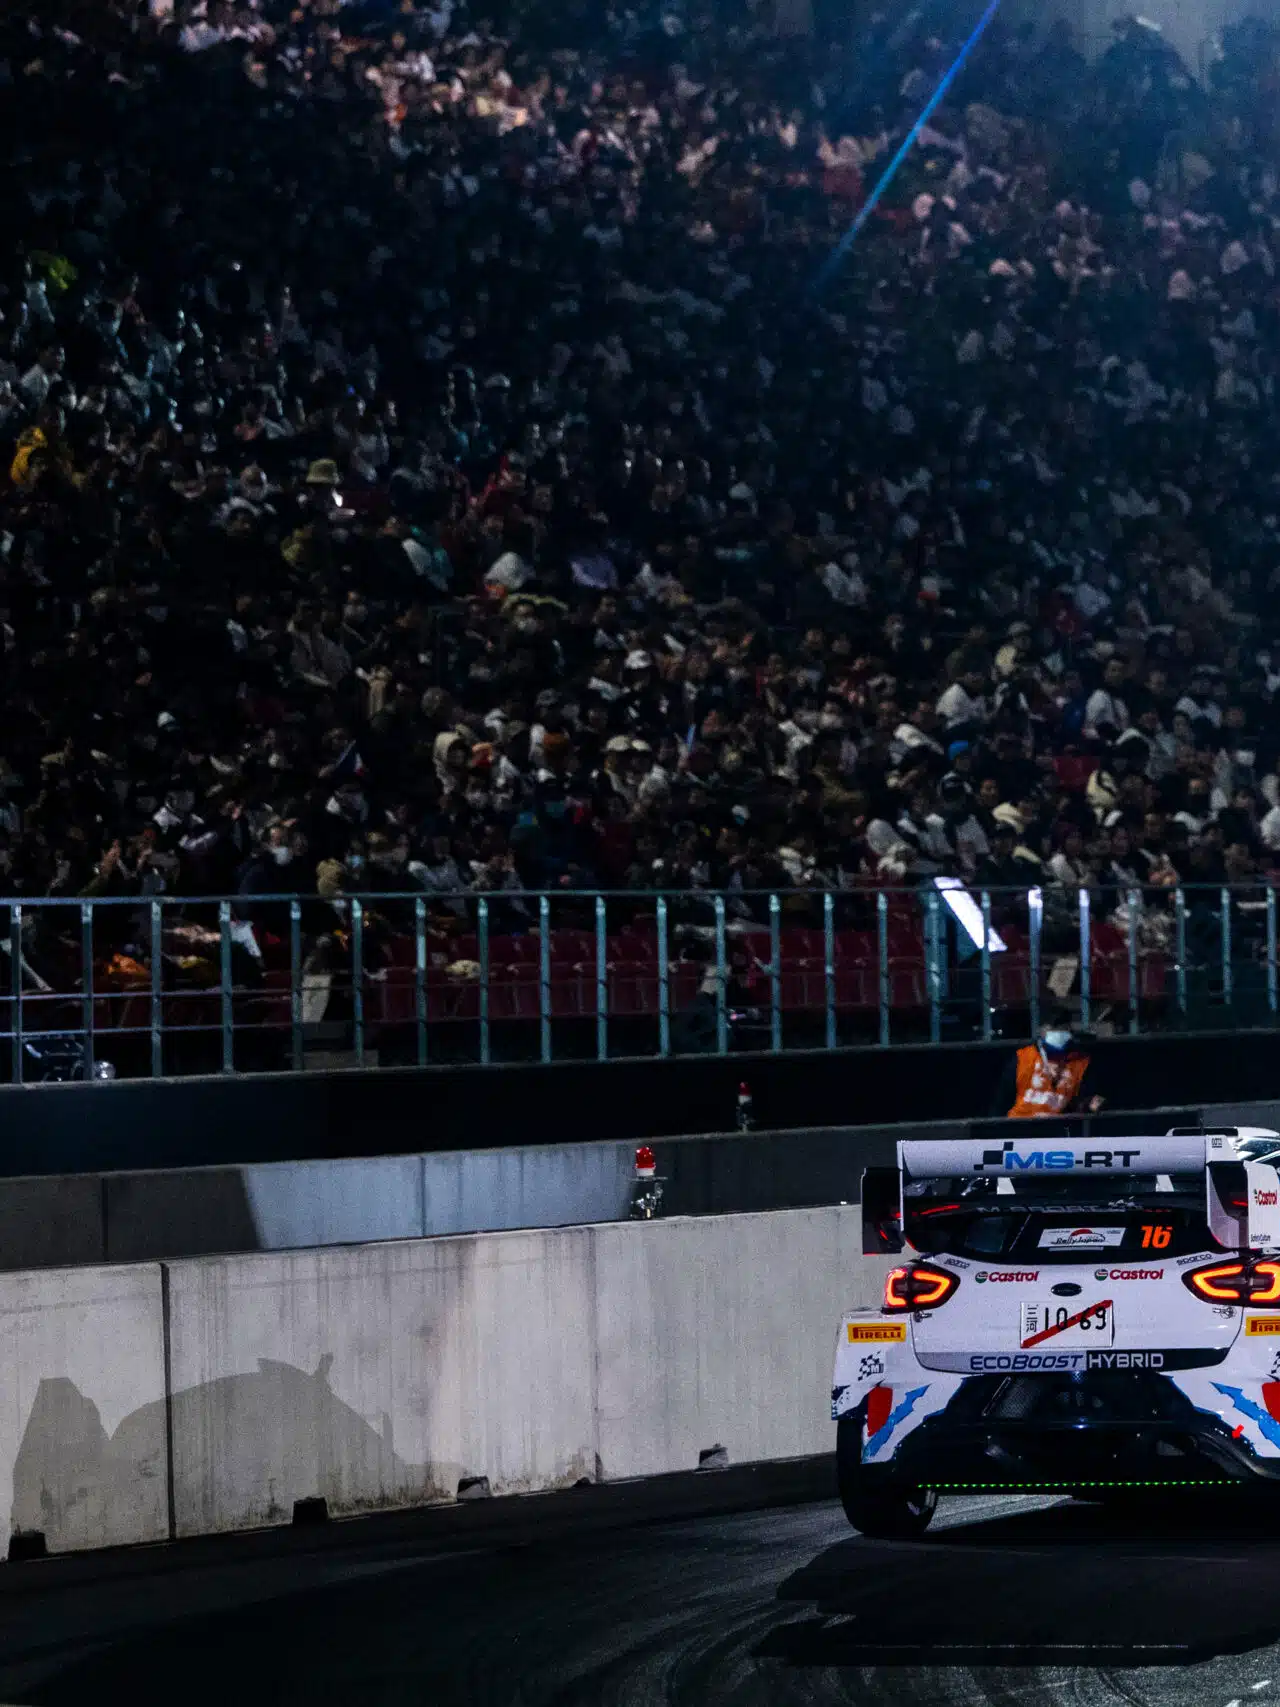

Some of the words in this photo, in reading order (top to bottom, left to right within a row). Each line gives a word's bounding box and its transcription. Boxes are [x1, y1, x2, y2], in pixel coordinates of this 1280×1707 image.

[1004, 1150, 1141, 1170] MS-RT
[1258, 1189, 1278, 1205] Castrol
[1140, 1225, 1173, 1249] 16
[1176, 1253, 1213, 1266] sparco
[988, 1271, 1040, 1283] Castrol
[1109, 1269, 1164, 1280] Castrol
[852, 1326, 902, 1340] PIRELLI
[1088, 1353, 1164, 1369] HYBRID
